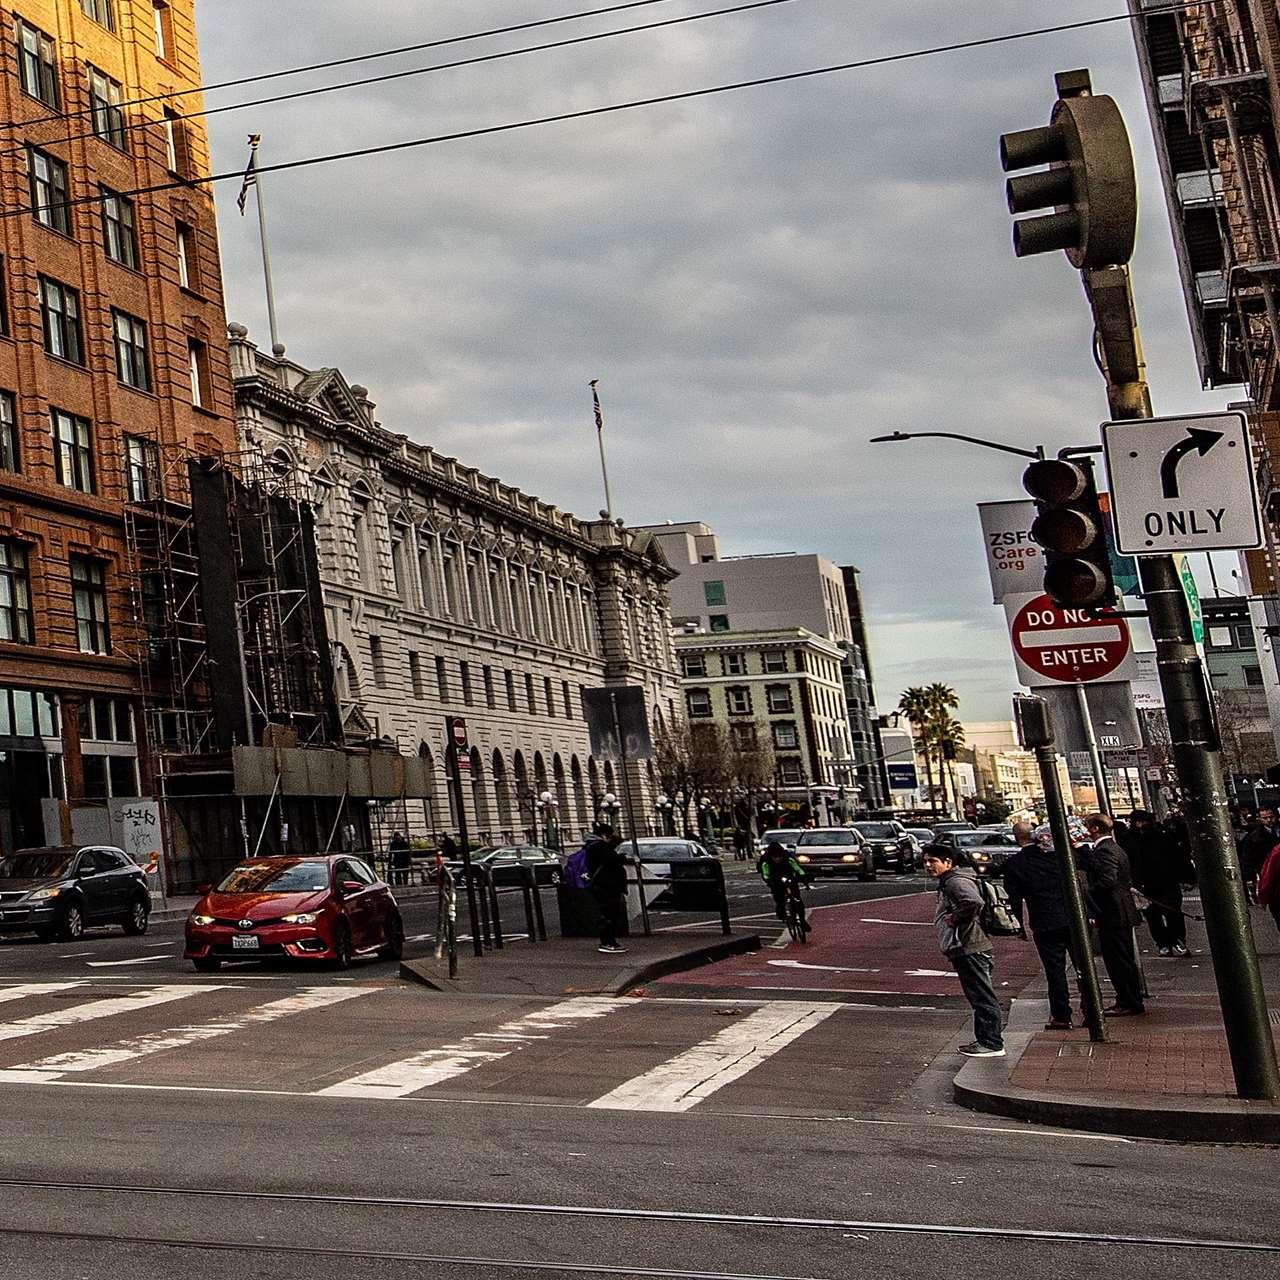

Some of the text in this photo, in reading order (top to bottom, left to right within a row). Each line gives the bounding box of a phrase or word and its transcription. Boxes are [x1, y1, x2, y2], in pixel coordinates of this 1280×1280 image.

[1144, 508, 1227, 538] ONLY
[992, 547, 1037, 560] Care
[995, 560, 1026, 571] .org
[1027, 610, 1055, 626] DO
[1040, 648, 1108, 666] ENTER
